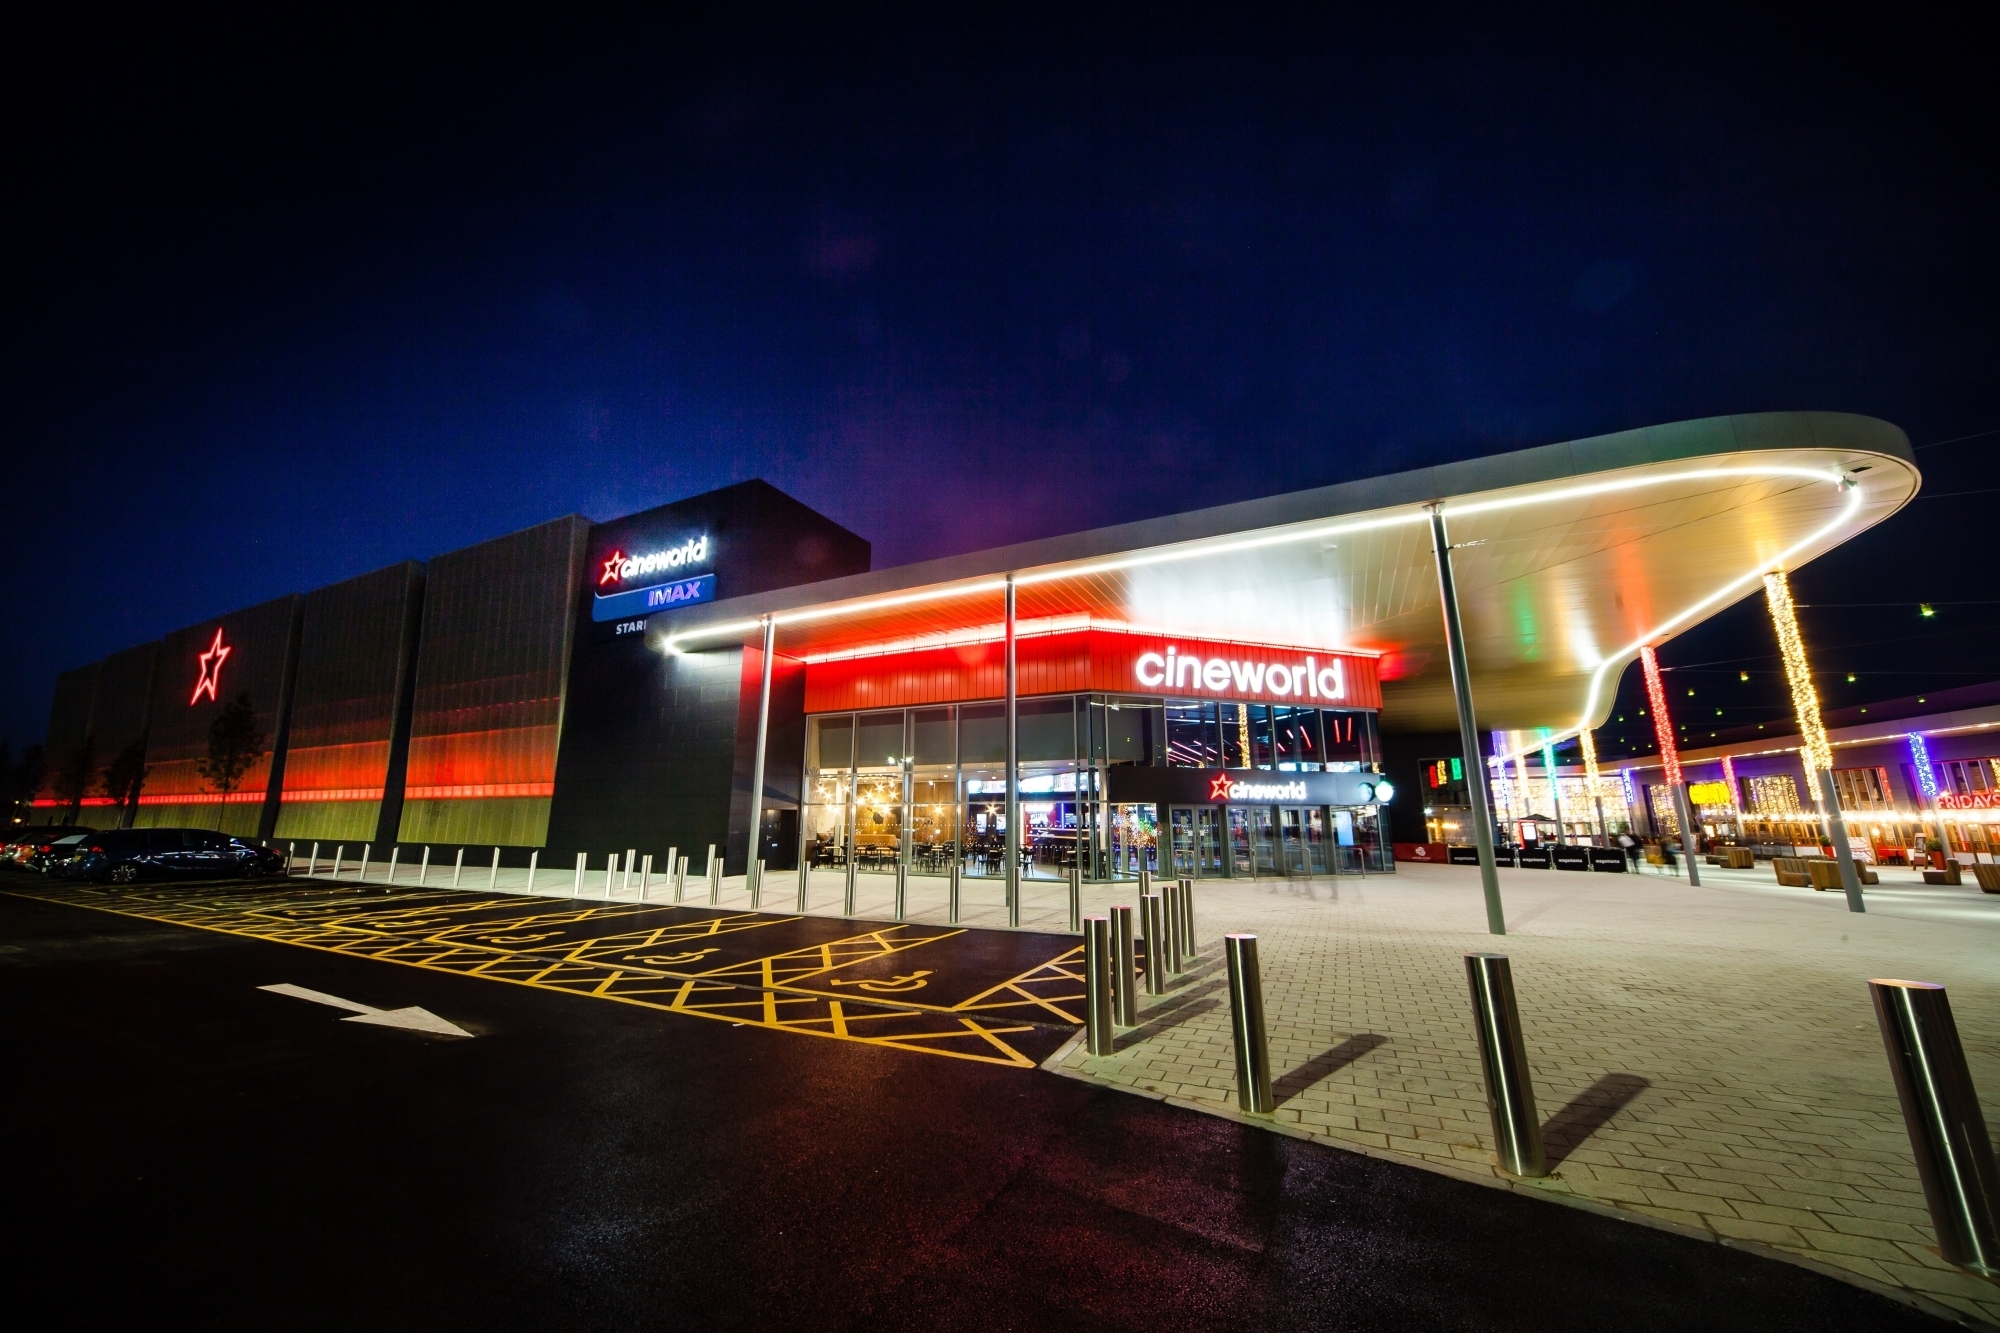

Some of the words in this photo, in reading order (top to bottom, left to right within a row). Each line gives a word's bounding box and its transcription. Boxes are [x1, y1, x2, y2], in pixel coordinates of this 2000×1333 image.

[620, 536, 707, 578] cineworld
[648, 581, 700, 607] IMAX
[1135, 646, 1345, 699] cineworld
[1229, 781, 1307, 799] cineworld
[1936, 795, 2000, 809] FRIDAYS
